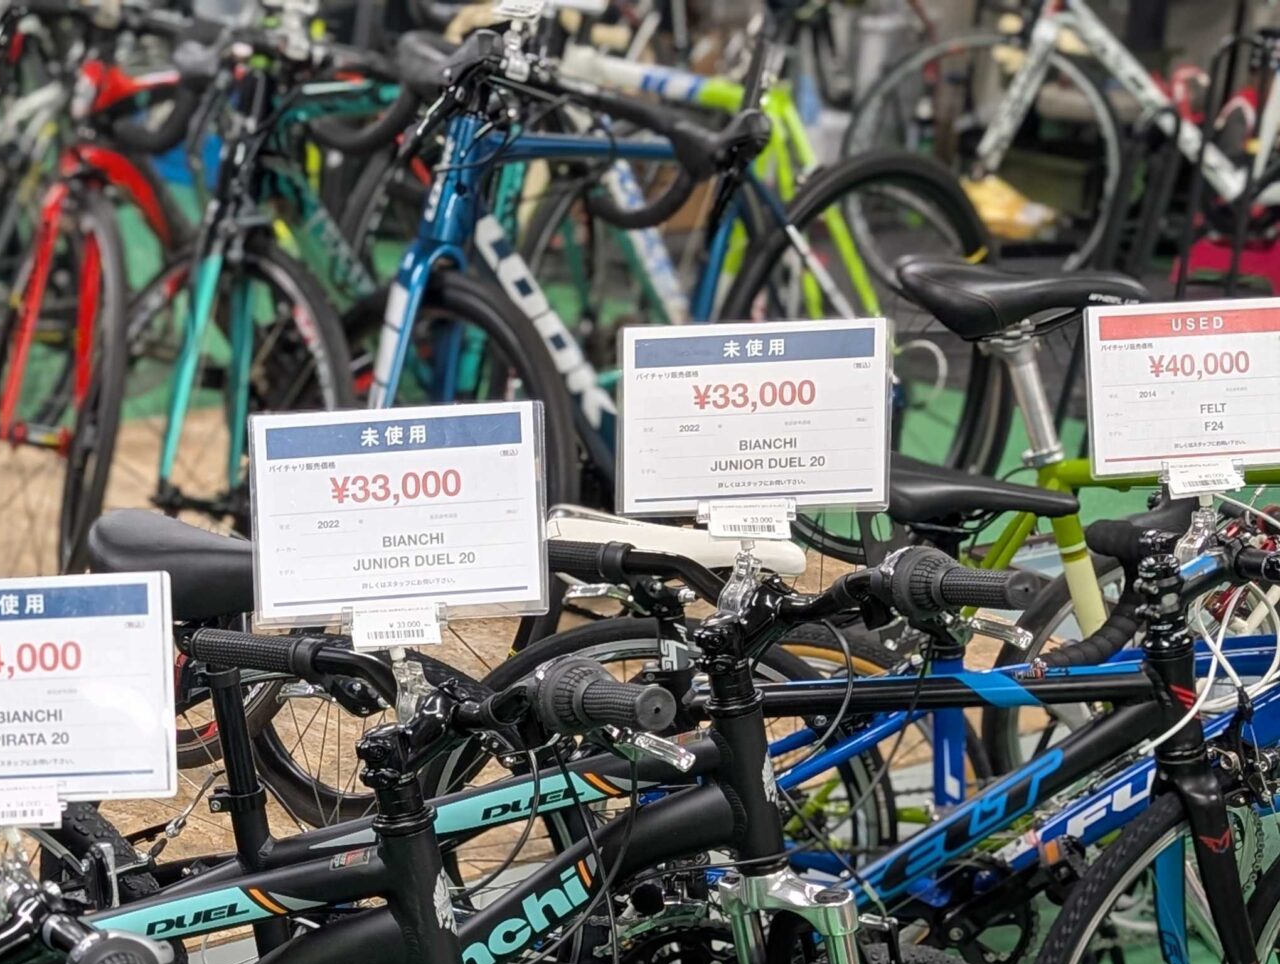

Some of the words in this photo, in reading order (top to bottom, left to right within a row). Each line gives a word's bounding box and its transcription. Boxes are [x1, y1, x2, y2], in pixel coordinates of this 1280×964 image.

[1171, 316, 1224, 332] USED
[722, 338, 786, 358] 未使用
[1148, 350, 1250, 381] ¥40,000
[693, 379, 817, 412] ¥33,000
[1138, 391, 1157, 399] 2014
[1199, 402, 1227, 414] FELT
[679, 424, 700, 433] 2022
[1204, 420, 1224, 432] F24
[360, 424, 428, 447] 未使用
[739, 437, 798, 451] BIANCHI
[710, 459, 764, 472] JUNIOR
[768, 457, 806, 469] DUEL
[809, 456, 826, 467] 20
[329, 469, 462, 505] ¥33,000
[317, 520, 340, 529] 2022
[381, 532, 445, 548] BIANCHI
[352, 556, 410, 572] JUNIOR
[414, 554, 455, 568] DUEL
[458, 552, 476, 564] 20
[51, 731, 70, 745] 20
[145, 902, 250, 936] DUEL
